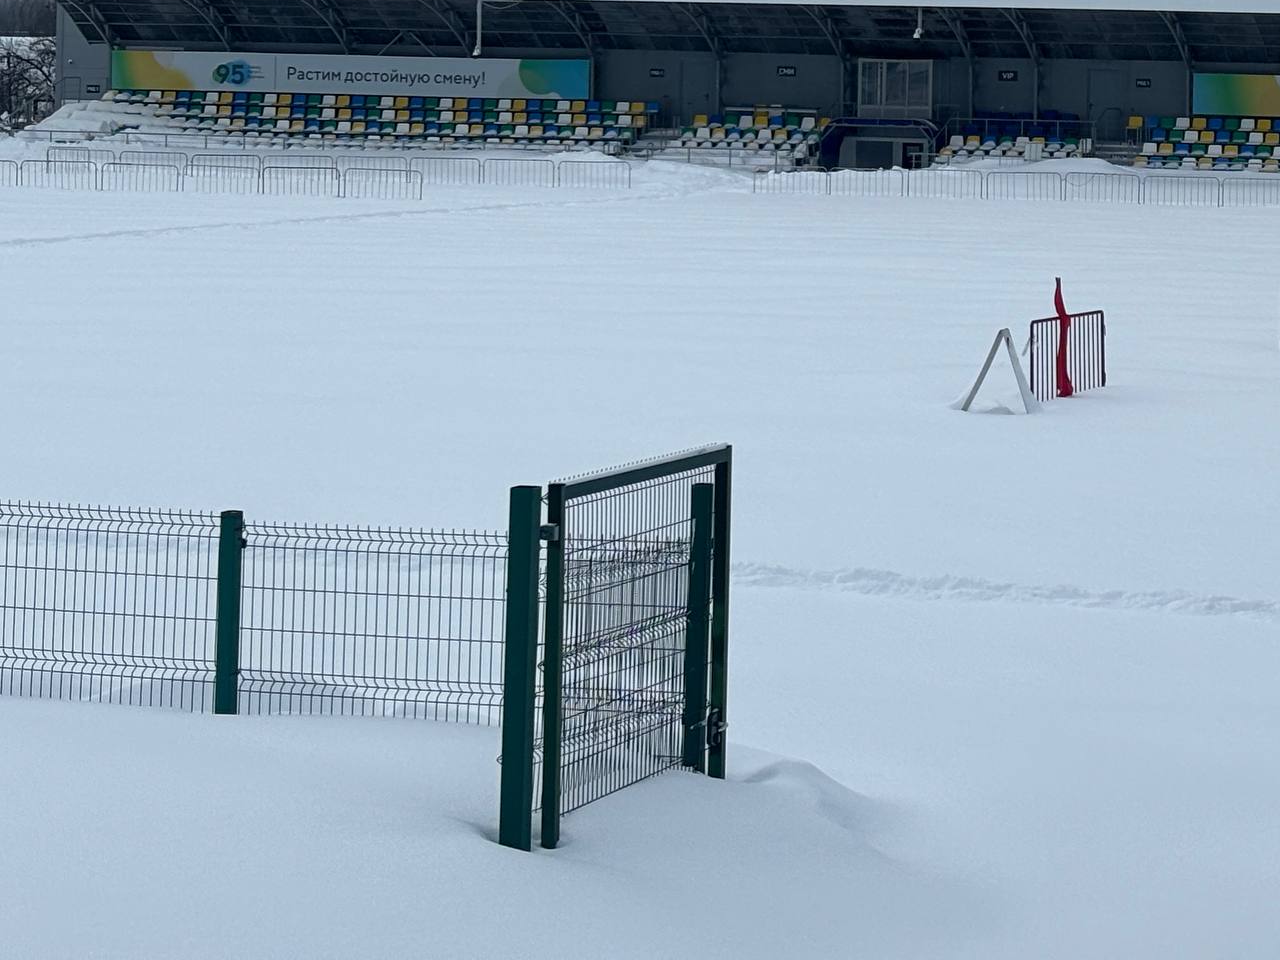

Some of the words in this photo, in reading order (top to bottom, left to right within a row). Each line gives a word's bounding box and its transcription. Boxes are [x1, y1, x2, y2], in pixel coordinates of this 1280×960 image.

[215, 64, 245, 84] 95
[287, 66, 341, 81] Растим
[344, 69, 431, 87] достойную
[433, 71, 486, 88] смену!
